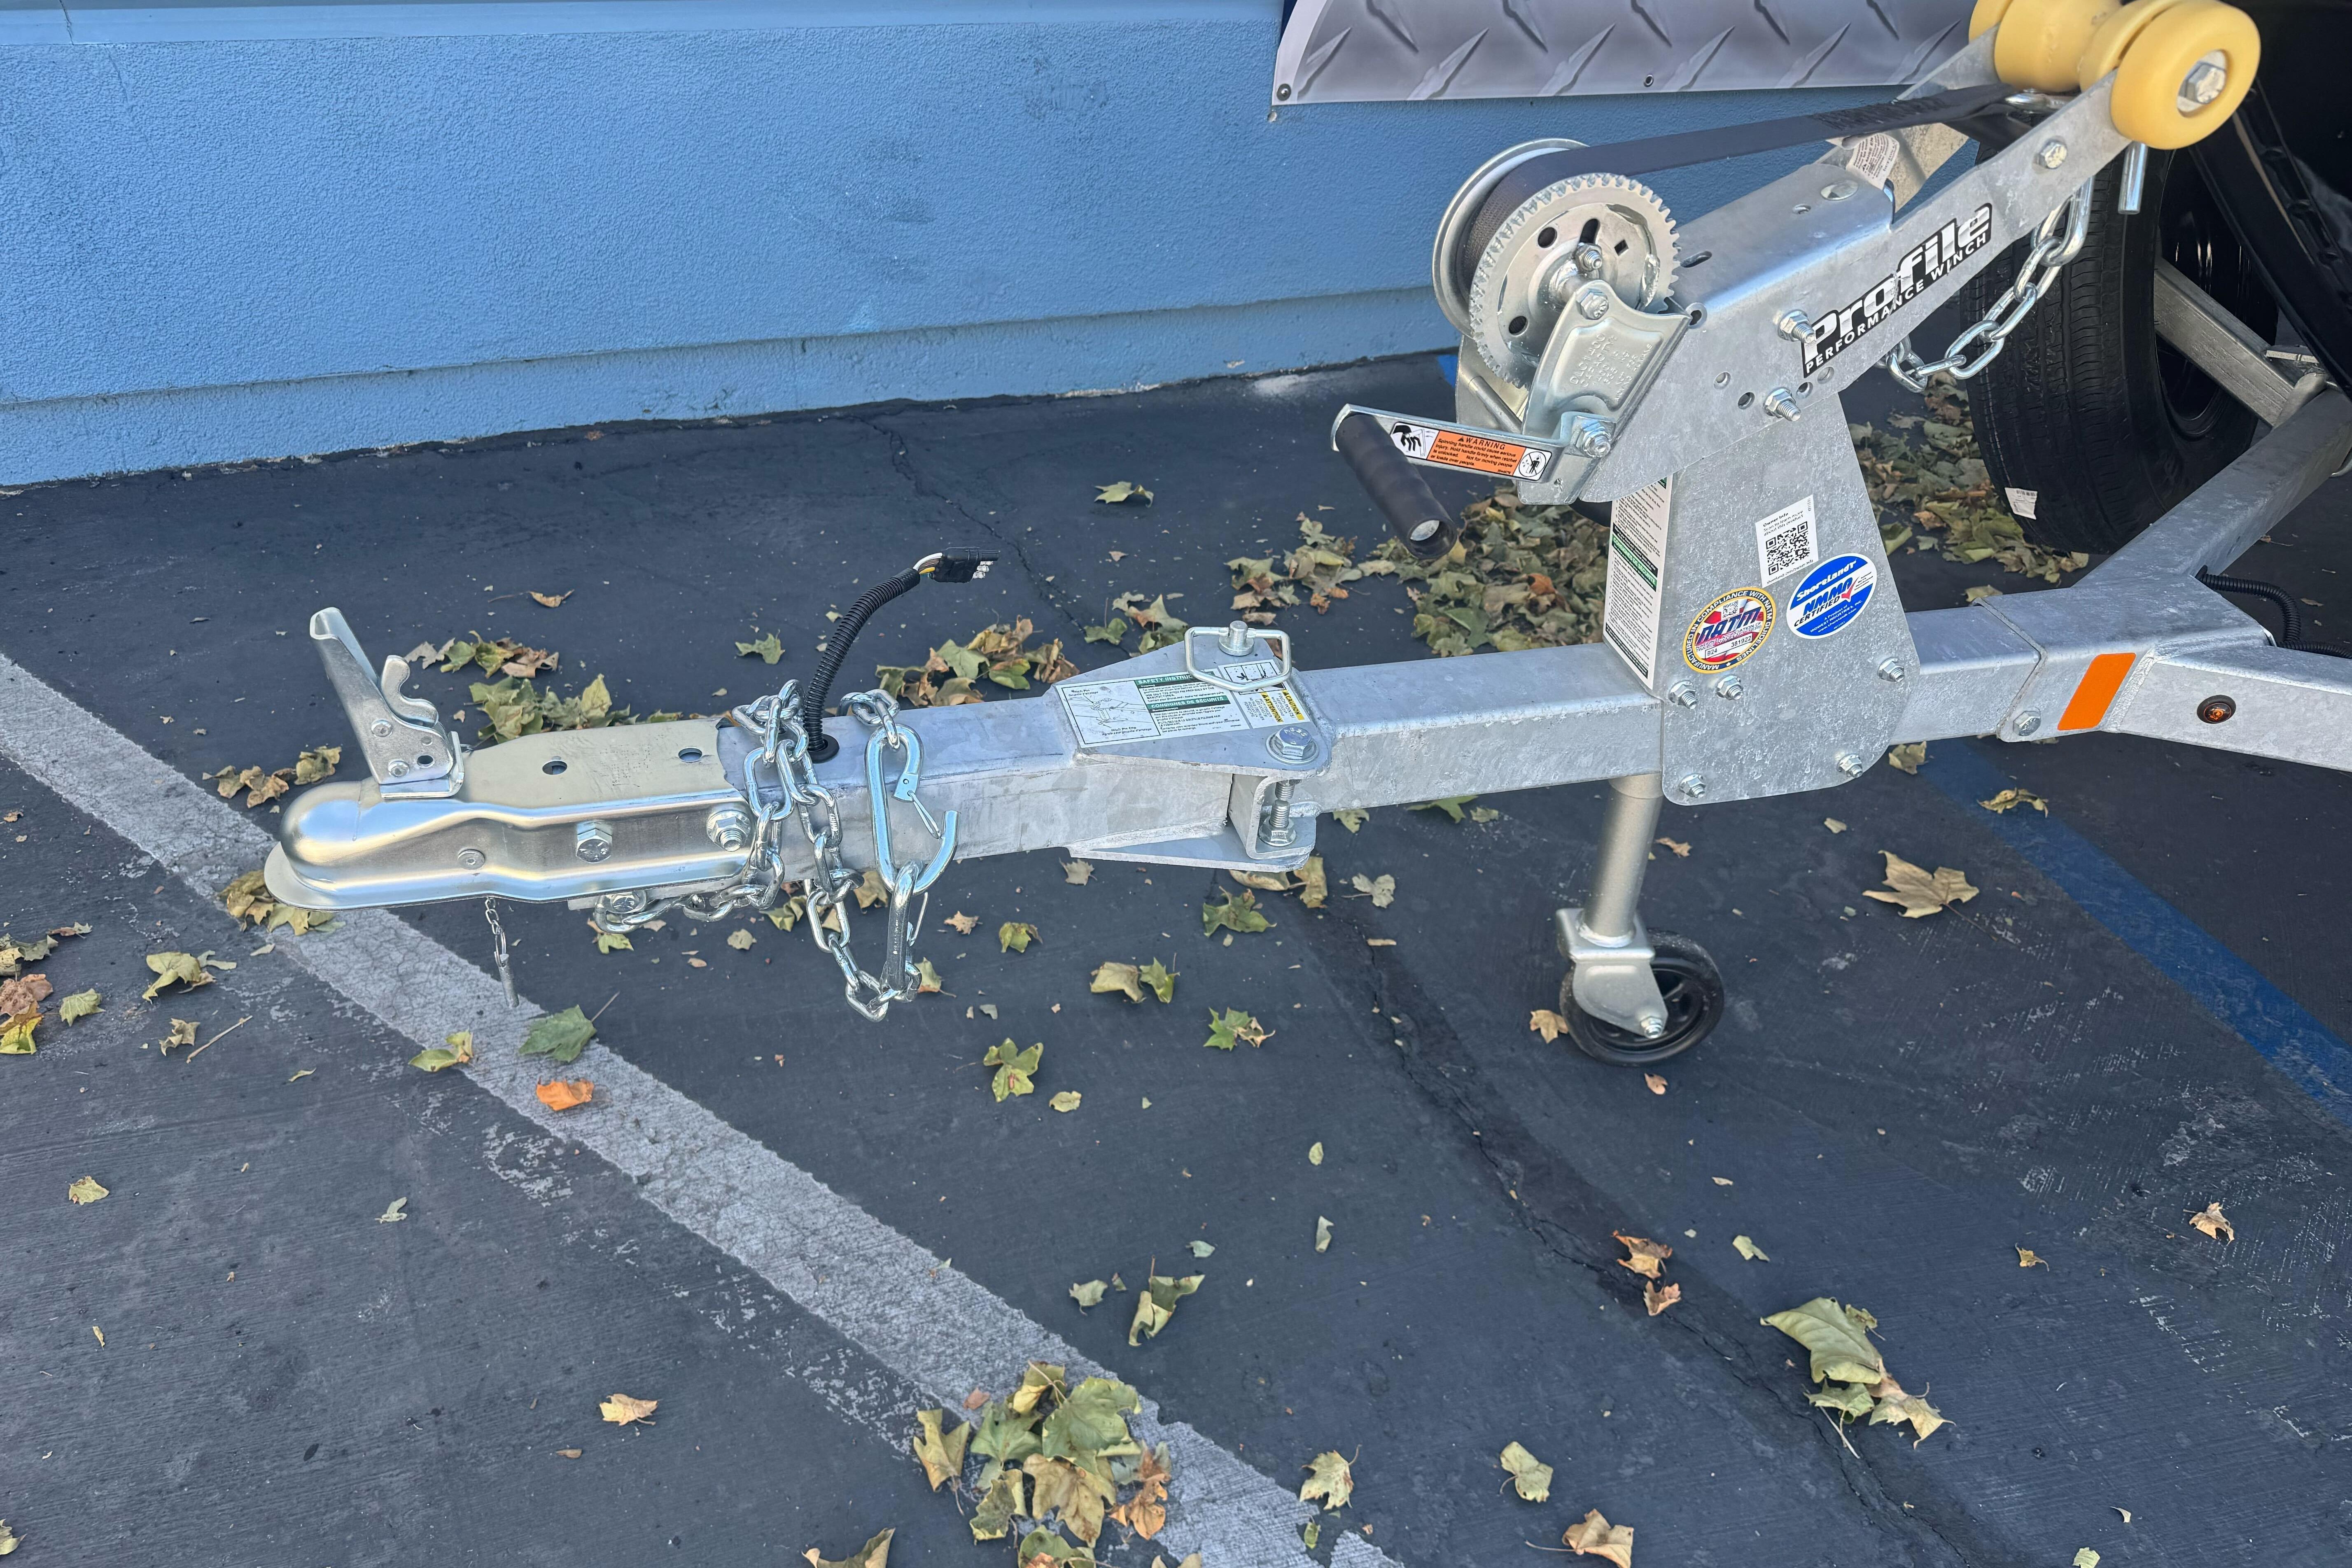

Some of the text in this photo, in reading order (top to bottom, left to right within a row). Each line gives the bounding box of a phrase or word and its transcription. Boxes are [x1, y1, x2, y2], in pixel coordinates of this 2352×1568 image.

[1805, 206, 1990, 364] Profile
[1806, 233, 1986, 374] PERFORMANCE WINCH
[1466, 437, 1505, 450] WARNING
[1763, 517, 1778, 527] Owner
[1764, 527, 1777, 536] about
[1786, 514, 1804, 526] product
[1780, 516, 1791, 525] learn
[1803, 577, 1853, 616] NMMA
[1794, 595, 1840, 627] CERTIFIED
[1686, 590, 1773, 670] MANUFACTURED IN COMPLIANCE WITH NATM GUIDELINES
[1696, 606, 1762, 646] NATM
[1731, 635, 1751, 648] 381922
[1164, 674, 1194, 682] INSTRUC
[1265, 696, 1283, 723] ATTENTION
[1286, 693, 1301, 715] CAUTION
